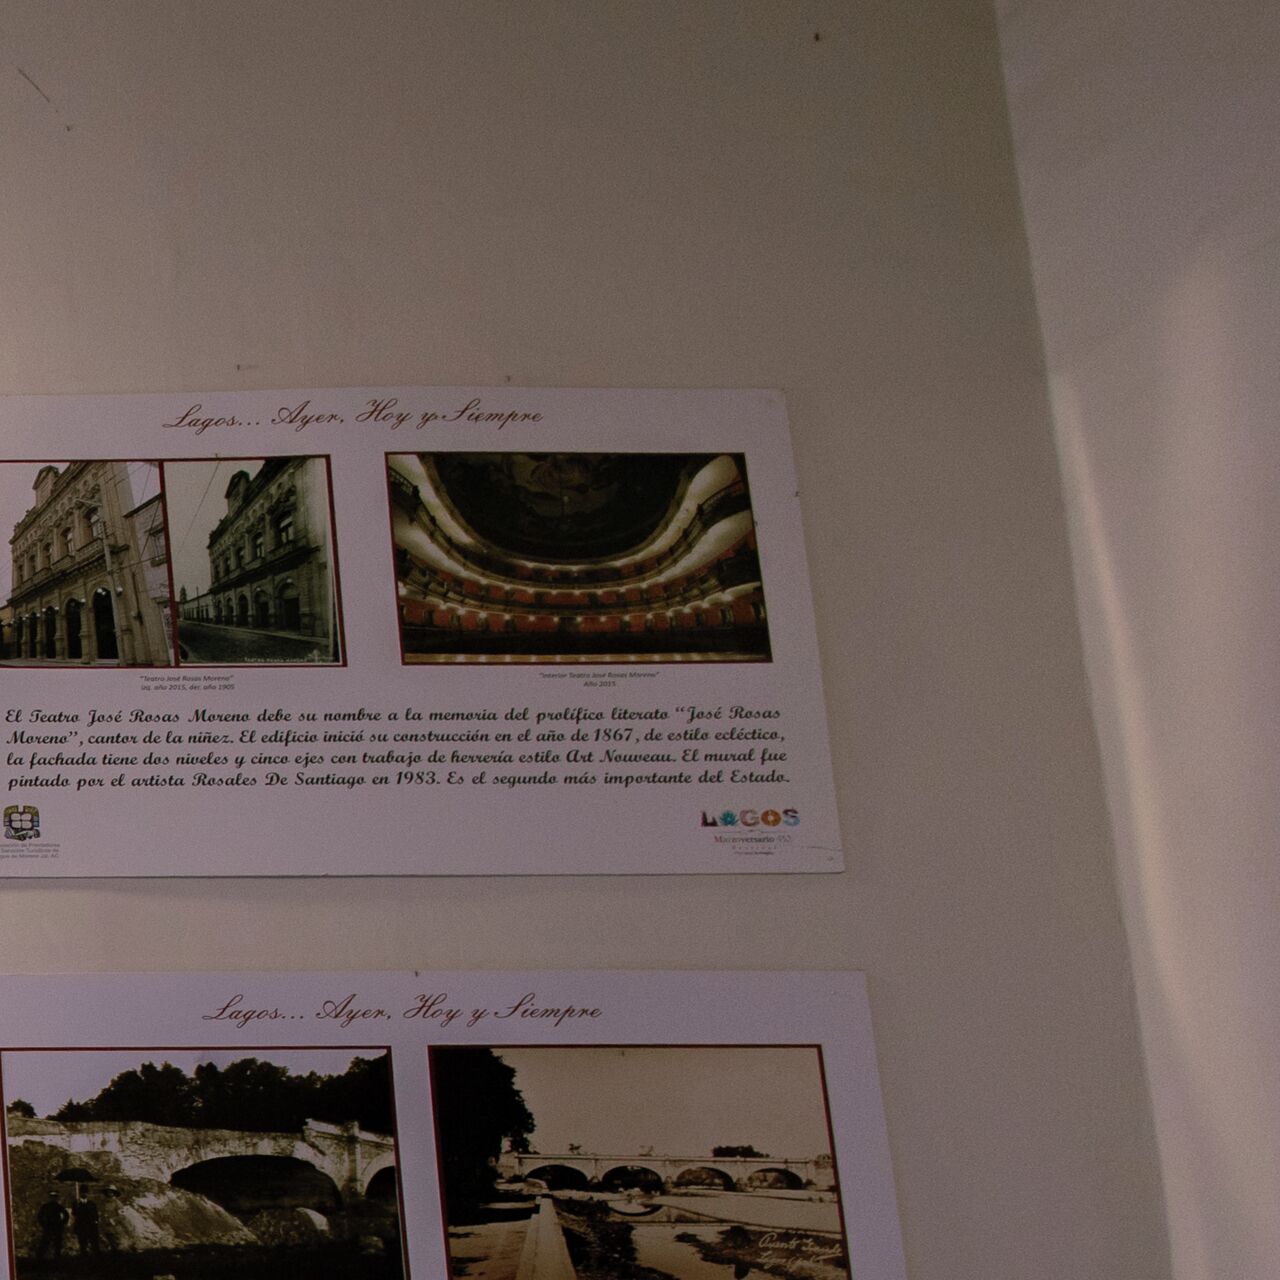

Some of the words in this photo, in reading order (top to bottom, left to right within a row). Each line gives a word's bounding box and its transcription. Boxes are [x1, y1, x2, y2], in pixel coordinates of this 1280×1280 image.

[162, 403, 260, 436] Lagos...
[271, 400, 344, 432] Ayer,
[355, 398, 413, 430] Hoy
[438, 398, 543, 430] Siempre
[8, 773, 70, 791] pintado
[76, 778, 105, 791] por
[110, 773, 125, 787] el
[131, 775, 185, 787] artista
[191, 772, 257, 786] Rosales
[265, 772, 288, 786] De
[294, 772, 366, 789] Santiago
[372, 776, 390, 785] en
[396, 771, 440, 785] 1983.
[446, 771, 464, 785] Es
[472, 771, 486, 785] el
[493, 771, 557, 788] segundo
[563, 772, 597, 784] más
[604, 772, 692, 788] importante
[698, 770, 724, 783] del
[730, 769, 790, 783] Estado.
[201, 994, 304, 1028] Lagos...
[315, 993, 391, 1028] Ayer,
[403, 993, 463, 1028] Hoy
[466, 1008, 489, 1028] y
[494, 992, 602, 1028] Siempre
